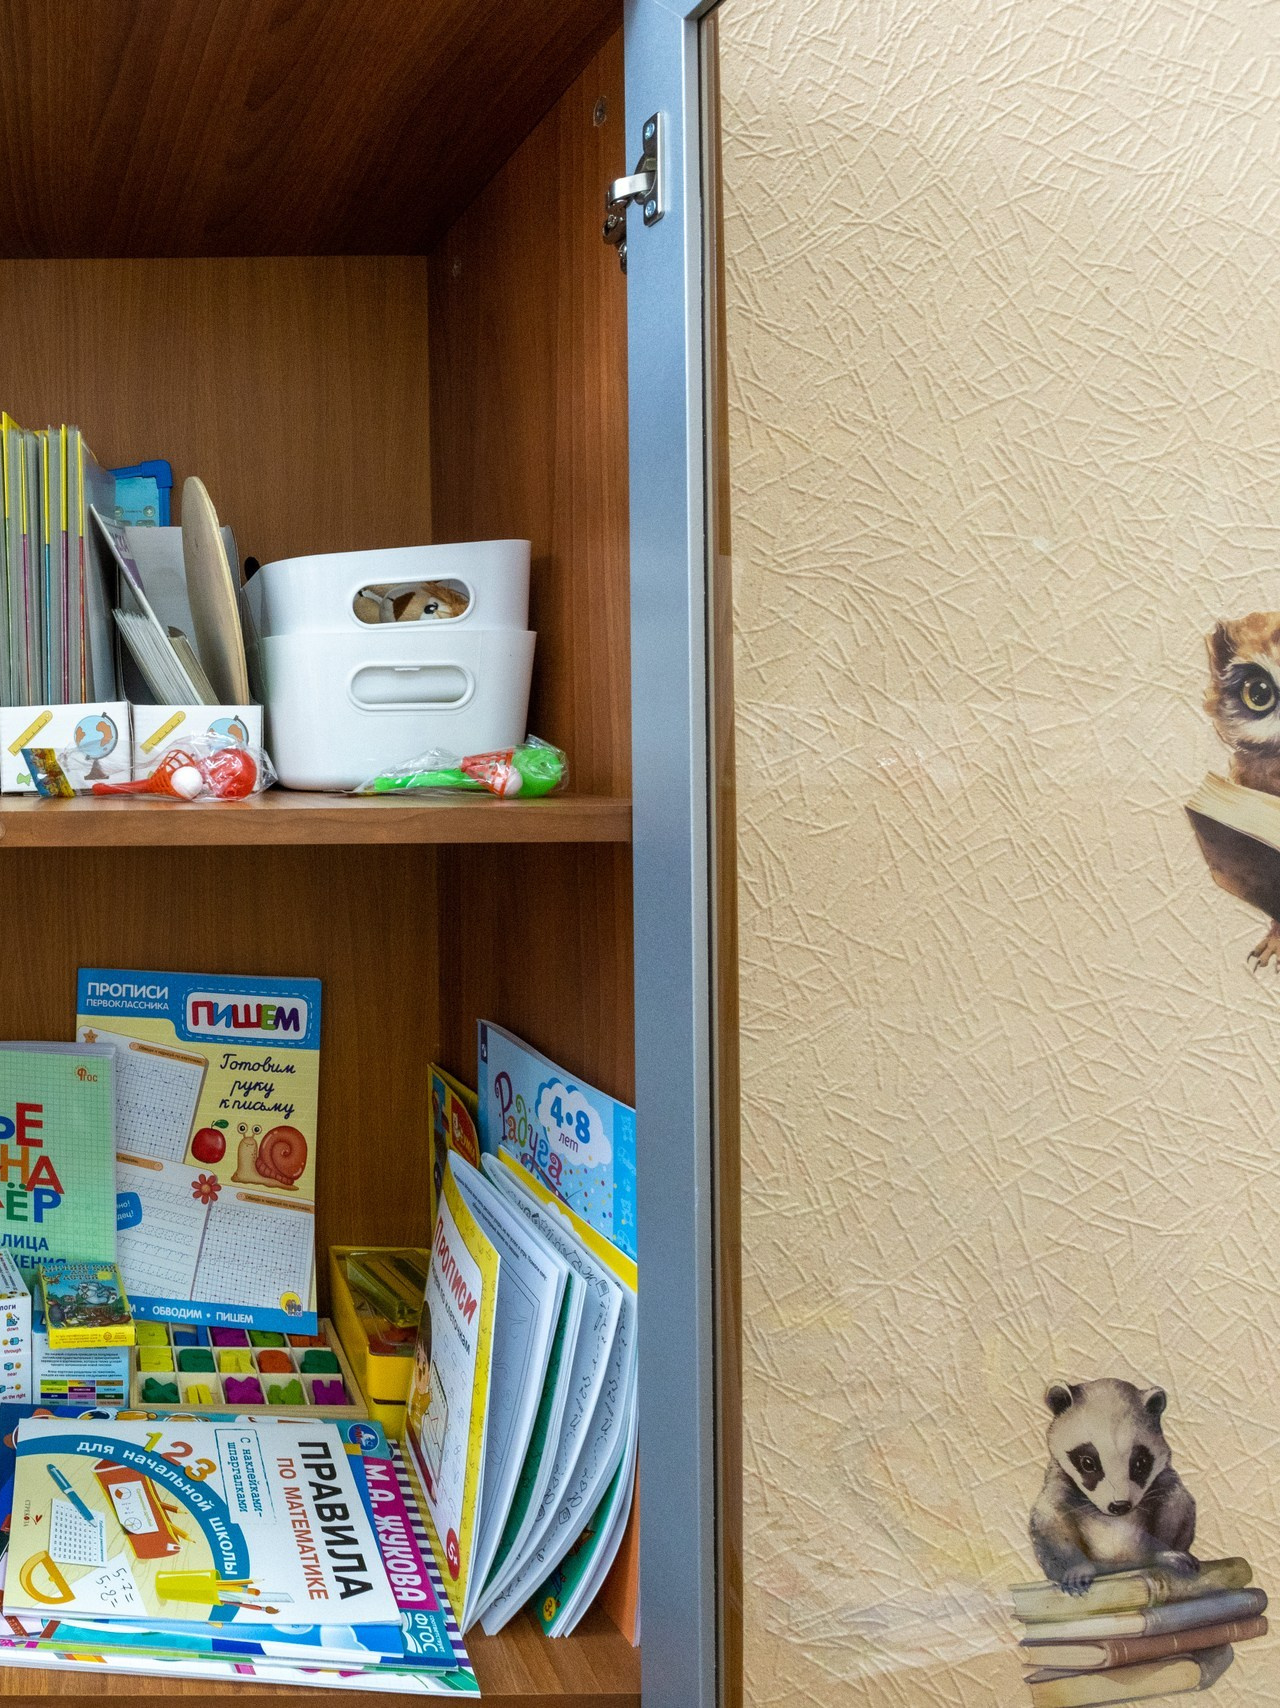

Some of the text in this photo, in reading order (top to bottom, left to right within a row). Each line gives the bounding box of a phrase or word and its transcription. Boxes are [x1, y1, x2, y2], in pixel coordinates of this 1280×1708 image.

[86, 999, 170, 1011] ПЕРВОКЛАССНИКА
[87, 982, 169, 1000] ПРОПИСИ
[191, 1000, 300, 1032] ПИШЕМ
[220, 1053, 296, 1074] Готовим
[219, 1098, 295, 1119] к письму
[230, 1080, 274, 1098] руку
[495, 1072, 562, 1186] Радуга
[559, 1133, 578, 1153] лет
[153, 1306, 253, 1324] ОБВОДИМ ПИШЕМ
[144, 1431, 217, 1482] 1 2 3
[228, 1442, 248, 1513] шпаргалками
[243, 1449, 262, 1517] наклейками-
[77, 1441, 238, 1575] для начальной школы
[298, 1441, 373, 1600] ПРАВИЛА
[277, 1457, 329, 1600] ПО МАТЕМАТИКЕ
[370, 1515, 427, 1602] ЖУКОВА
[414, 1613, 439, 1653] ФГОС
